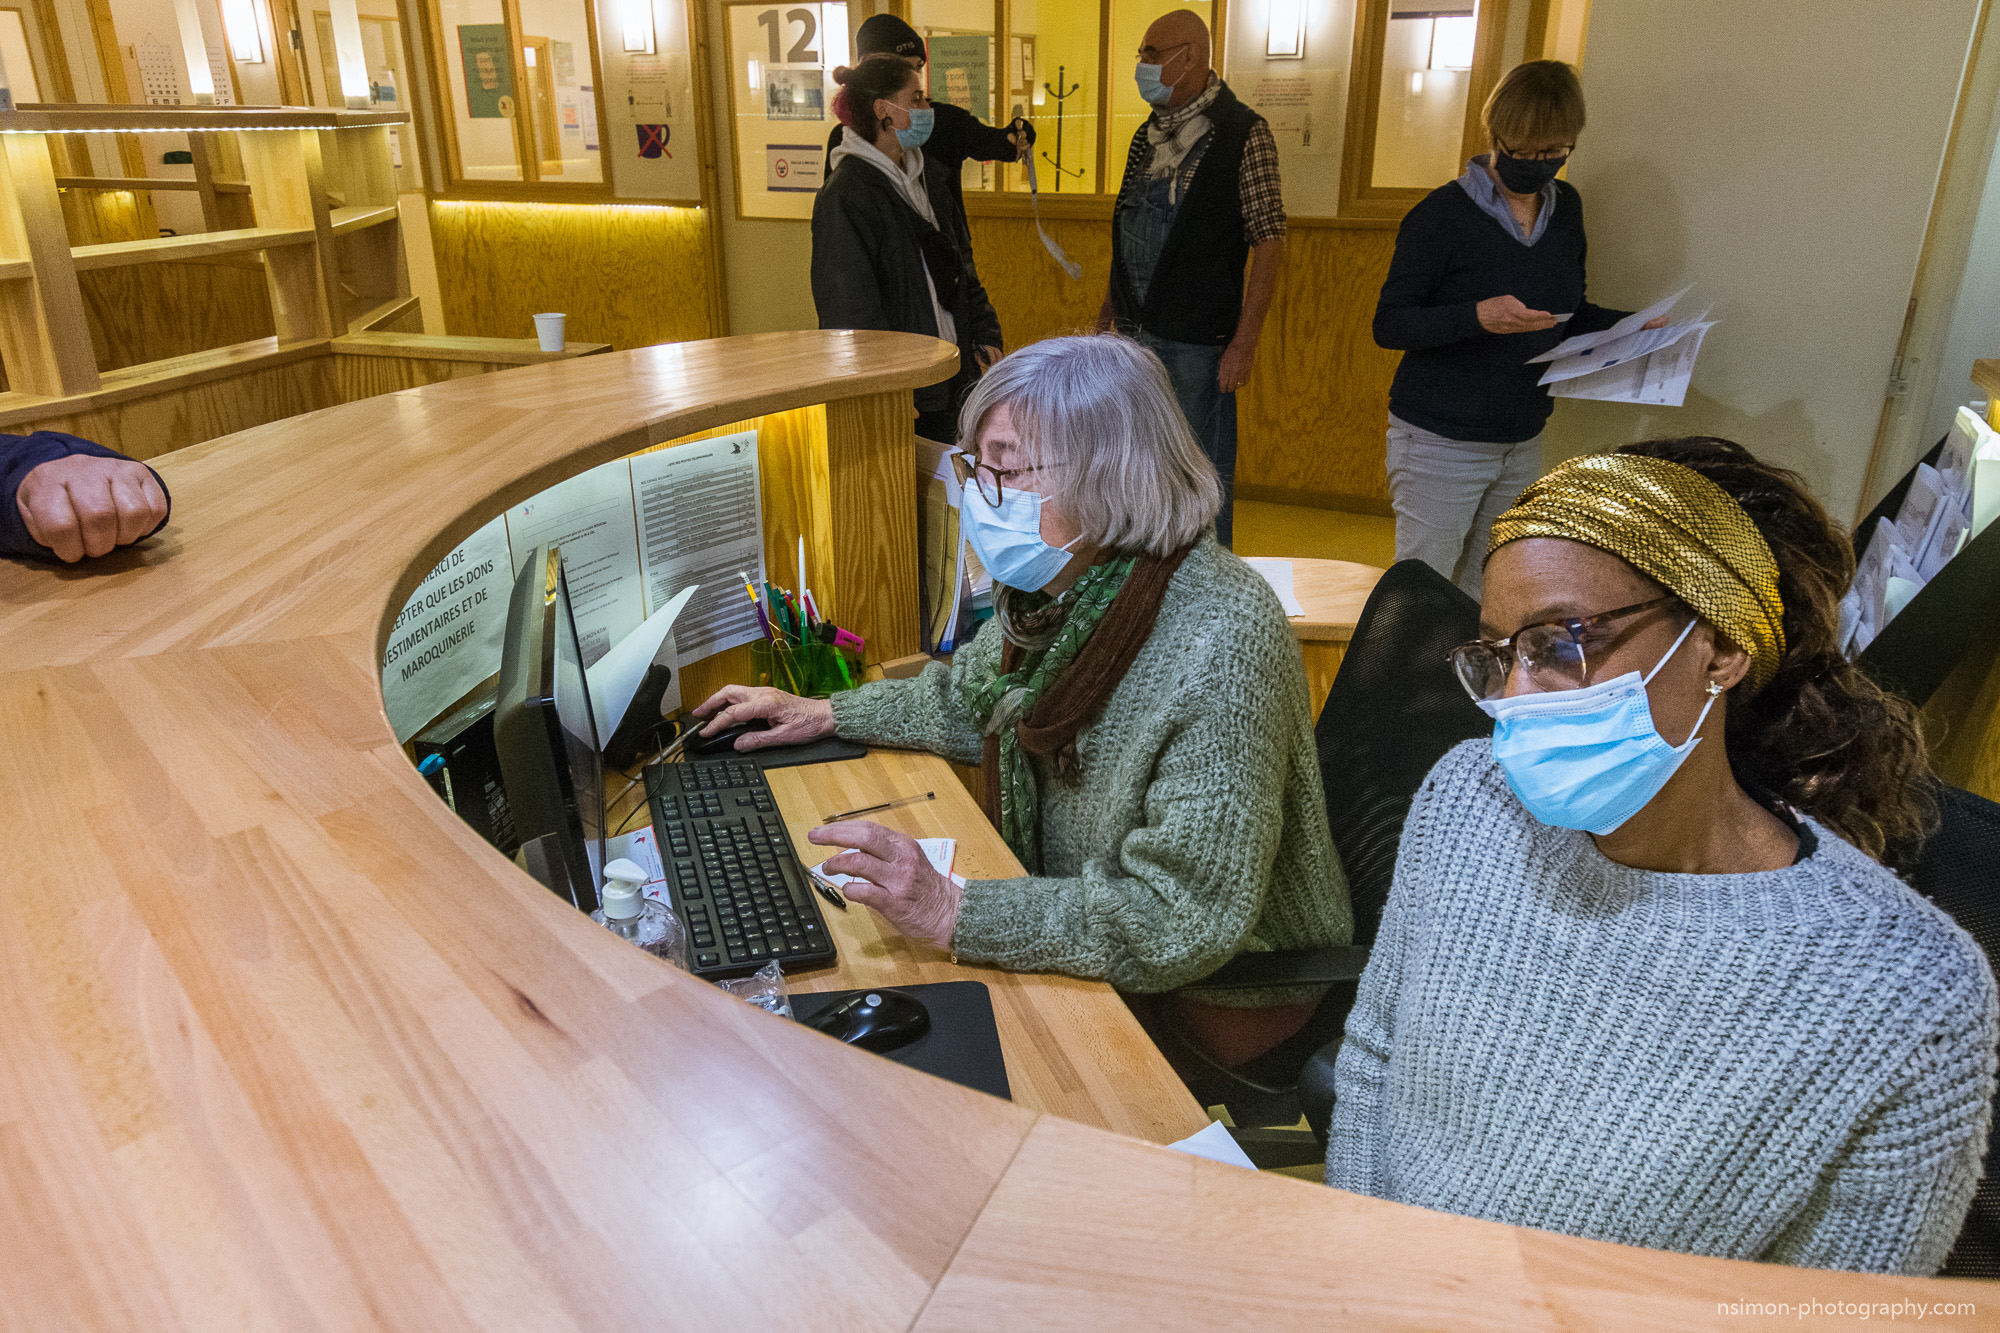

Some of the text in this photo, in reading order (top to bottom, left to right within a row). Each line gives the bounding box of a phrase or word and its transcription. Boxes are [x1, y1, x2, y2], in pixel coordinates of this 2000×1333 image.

[757, 8, 818, 63] 12
[452, 549, 465, 567] DE
[425, 586, 447, 608] QUE
[448, 575, 465, 595] LES
[466, 559, 494, 585] DONS
[461, 596, 473, 613] ET
[474, 587, 488, 605] DE
[401, 620, 476, 682] MAROQUINERIE
